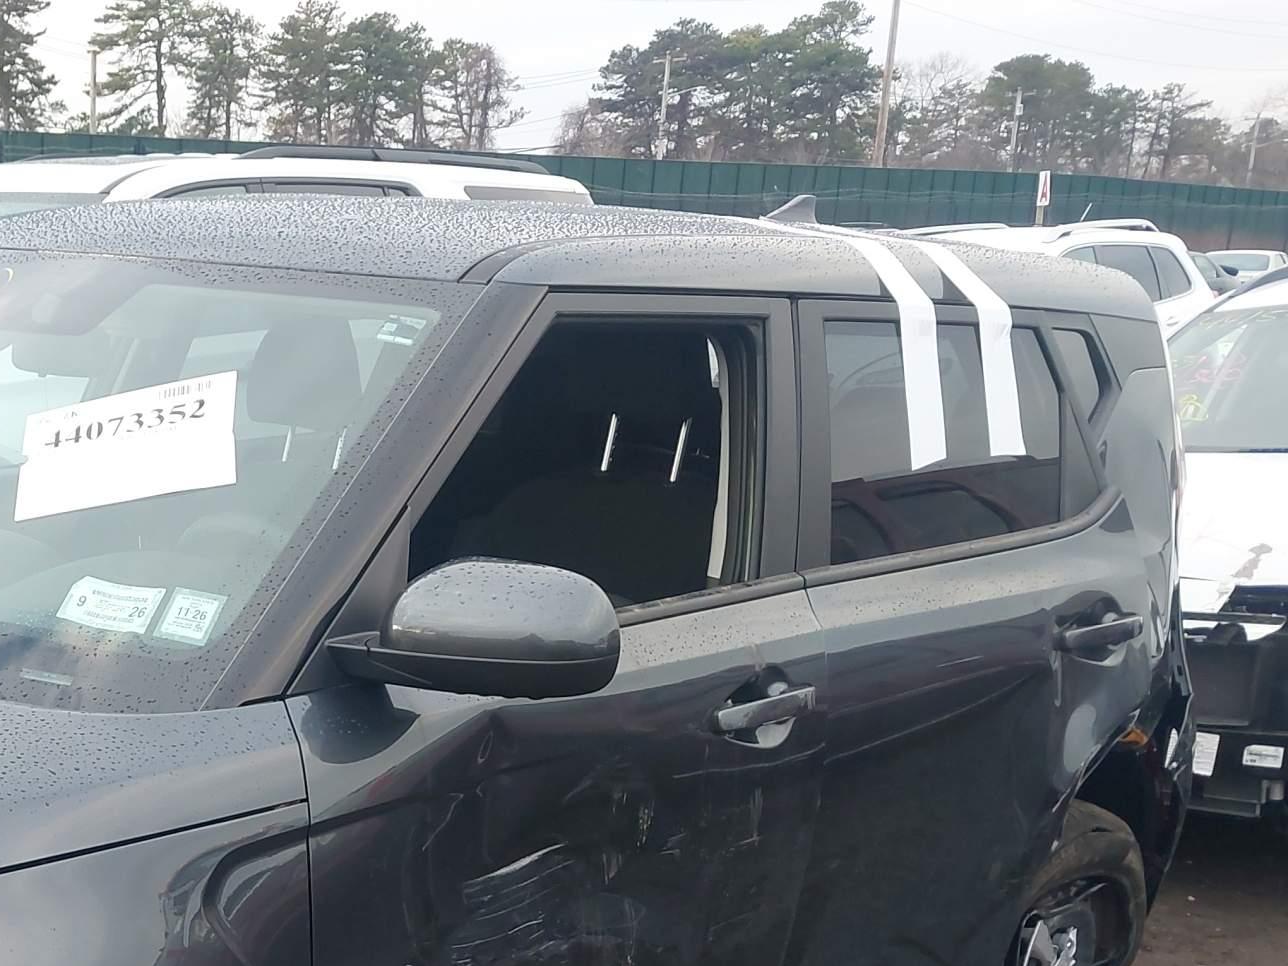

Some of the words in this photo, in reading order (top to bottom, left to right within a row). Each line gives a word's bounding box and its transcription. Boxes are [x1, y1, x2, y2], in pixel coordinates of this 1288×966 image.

[1040, 172, 1048, 203] A
[44, 398, 206, 448] 44073352
[76, 595, 88, 608] 9
[128, 606, 148, 619] 26
